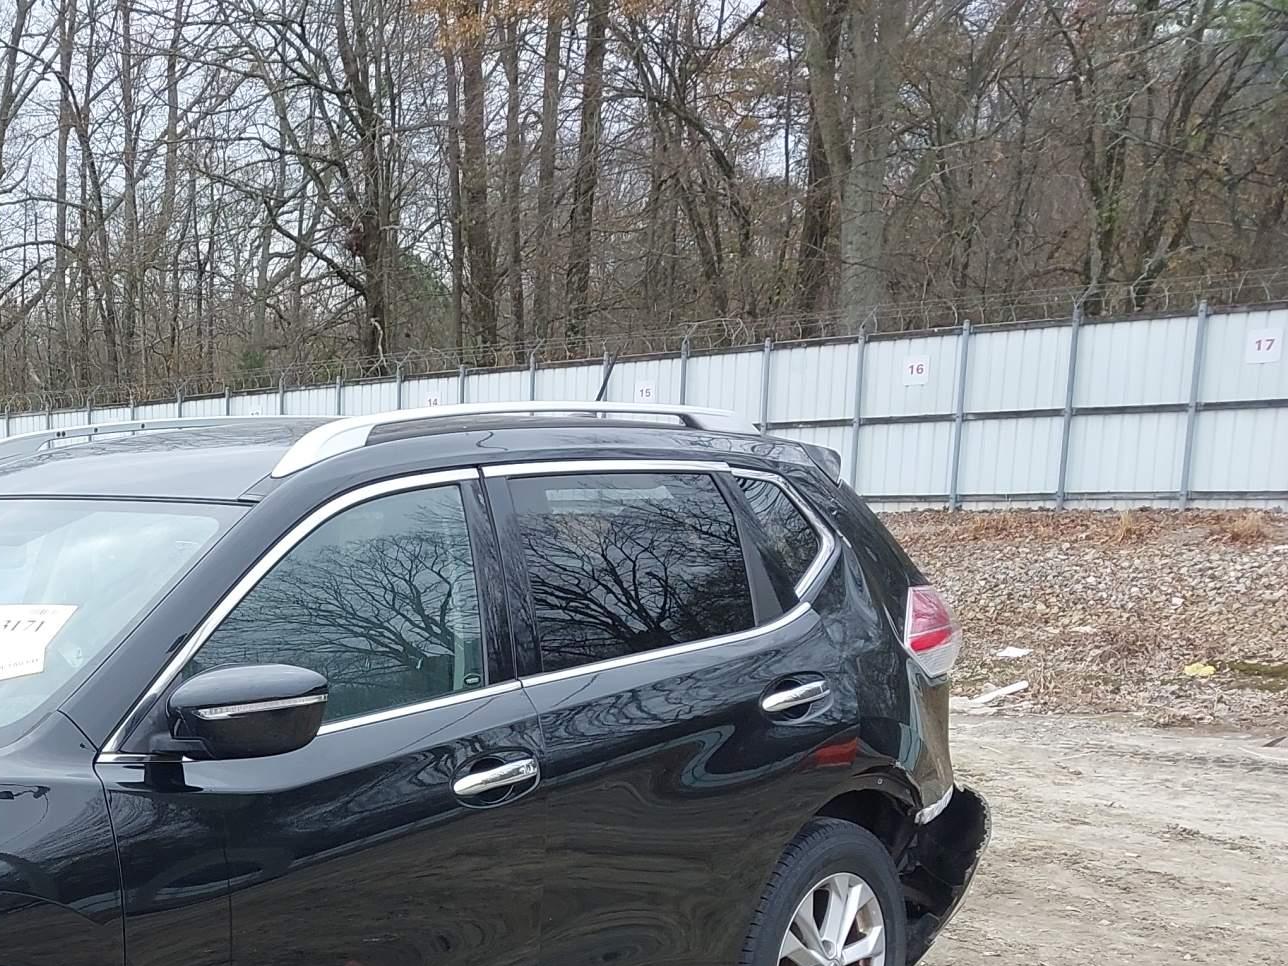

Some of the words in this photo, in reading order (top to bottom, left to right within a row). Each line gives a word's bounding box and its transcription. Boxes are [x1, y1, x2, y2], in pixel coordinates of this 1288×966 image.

[1255, 338, 1275, 351] 17
[908, 363, 924, 375] 16
[639, 388, 651, 398] 15
